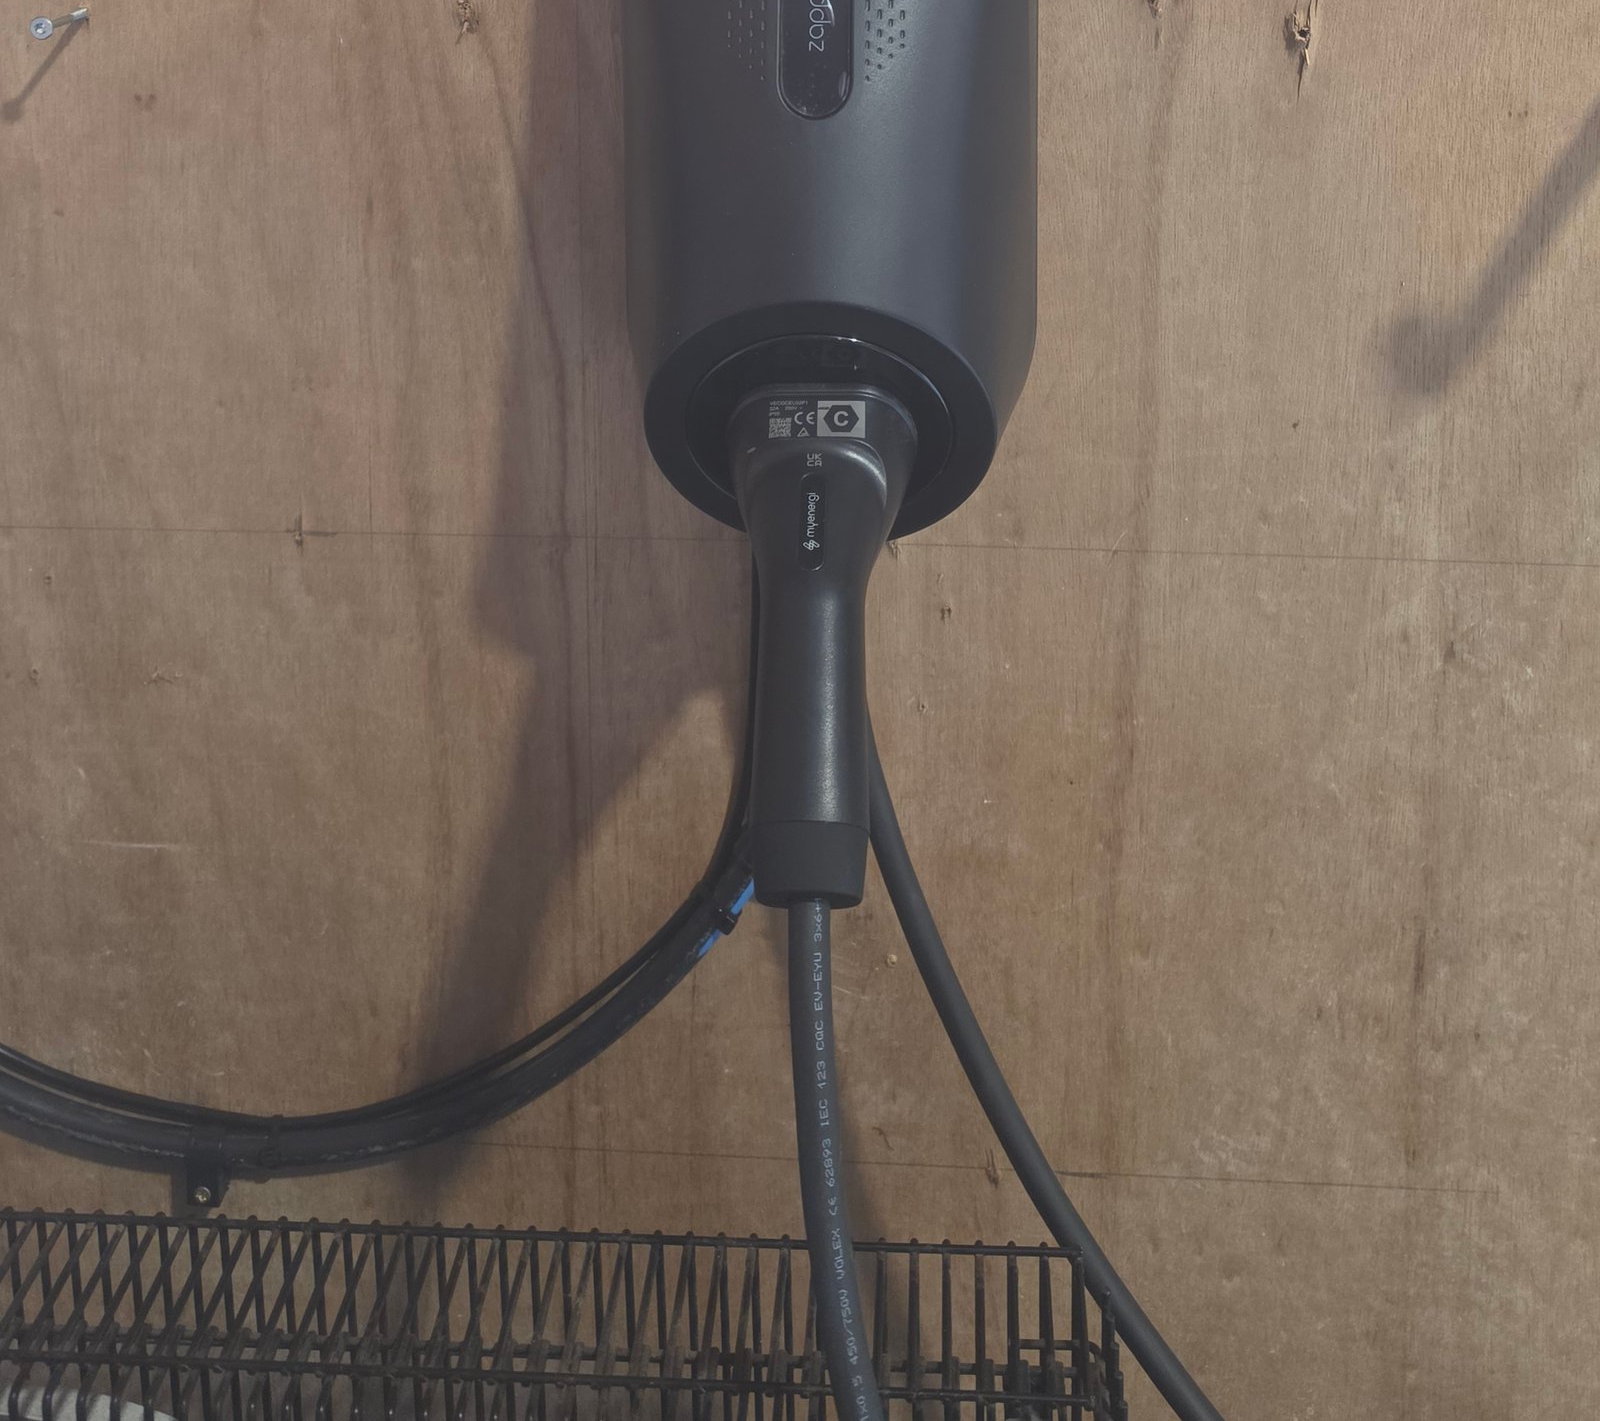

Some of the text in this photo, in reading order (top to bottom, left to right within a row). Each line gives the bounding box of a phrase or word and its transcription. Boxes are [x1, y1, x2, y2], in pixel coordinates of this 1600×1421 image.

[794, 412, 815, 425] CE
[834, 411, 849, 426] C
[807, 493, 820, 538] myenergi
[813, 952, 824, 1012] EV-EYU
[816, 1061, 827, 1090] 123
[819, 1099, 830, 1127] IEC
[822, 1138, 836, 1188] 62893
[832, 1228, 846, 1280] VOLEX
